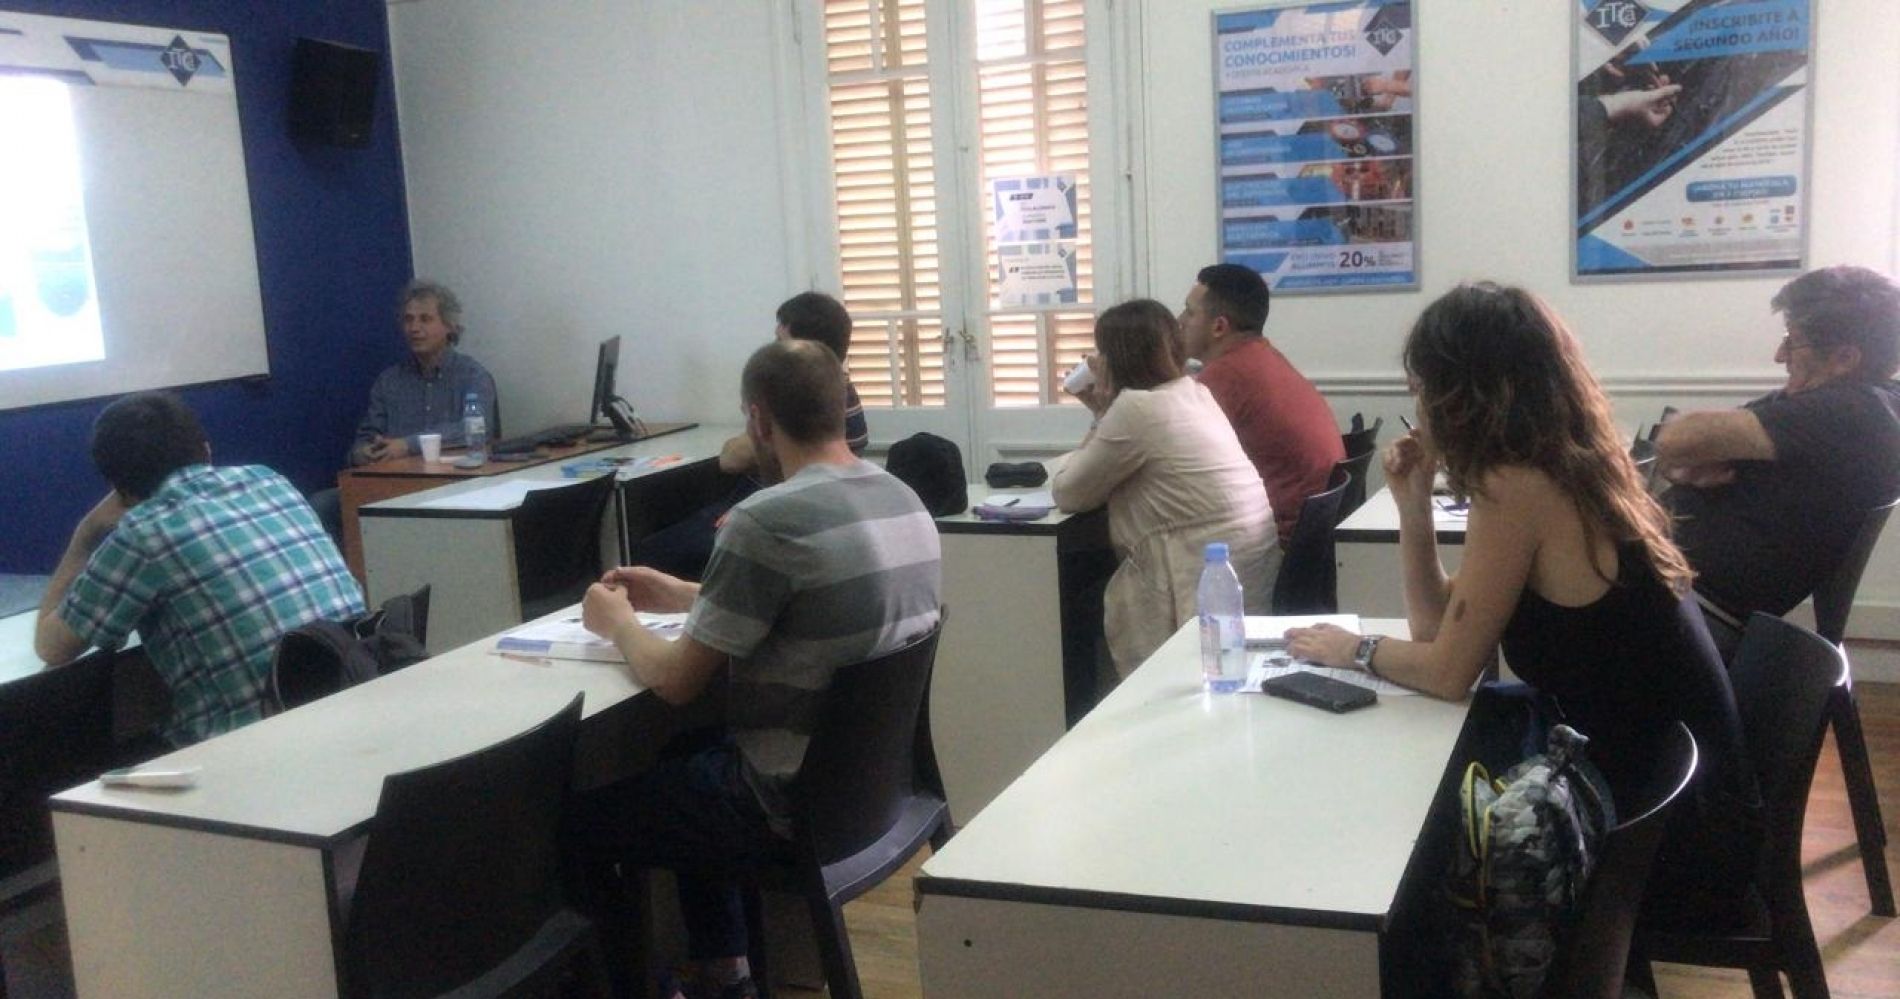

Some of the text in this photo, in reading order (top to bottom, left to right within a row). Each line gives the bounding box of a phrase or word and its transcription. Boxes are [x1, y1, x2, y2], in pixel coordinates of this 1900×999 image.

[1224, 33, 1327, 53] COMPLEMENTA
[1674, 32, 1751, 52] SEGUNDO
[1339, 250, 1377, 268] 20%
